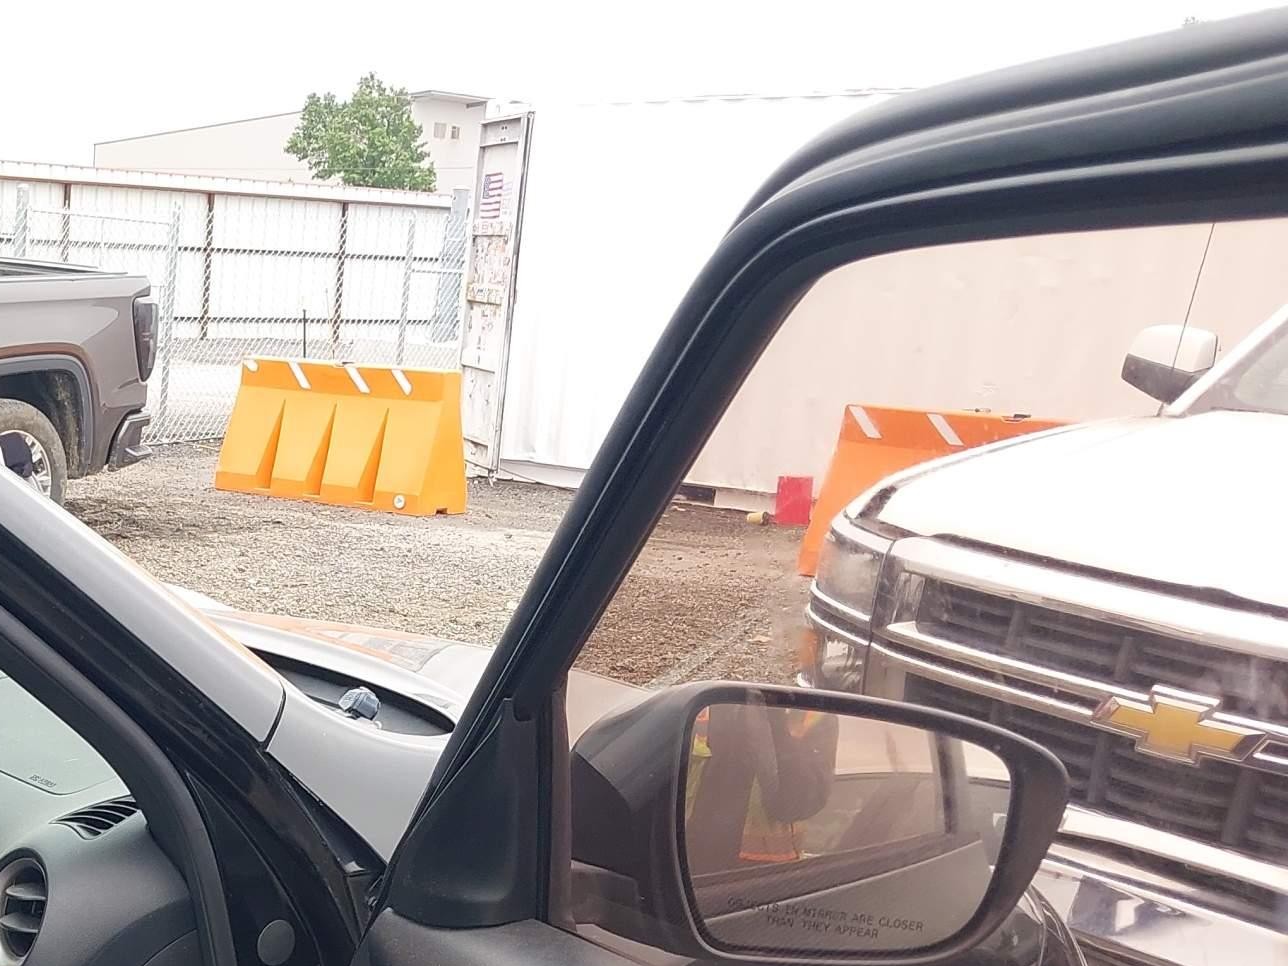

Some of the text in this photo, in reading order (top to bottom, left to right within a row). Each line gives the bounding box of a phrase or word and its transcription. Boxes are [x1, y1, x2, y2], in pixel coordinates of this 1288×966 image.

[767, 915, 880, 938] THAN THEY APPEAR
[785, 906, 799, 916] IN
[801, 908, 847, 923] MIRROR
[852, 913, 873, 926] ARE
[878, 916, 924, 932] CLOSER
